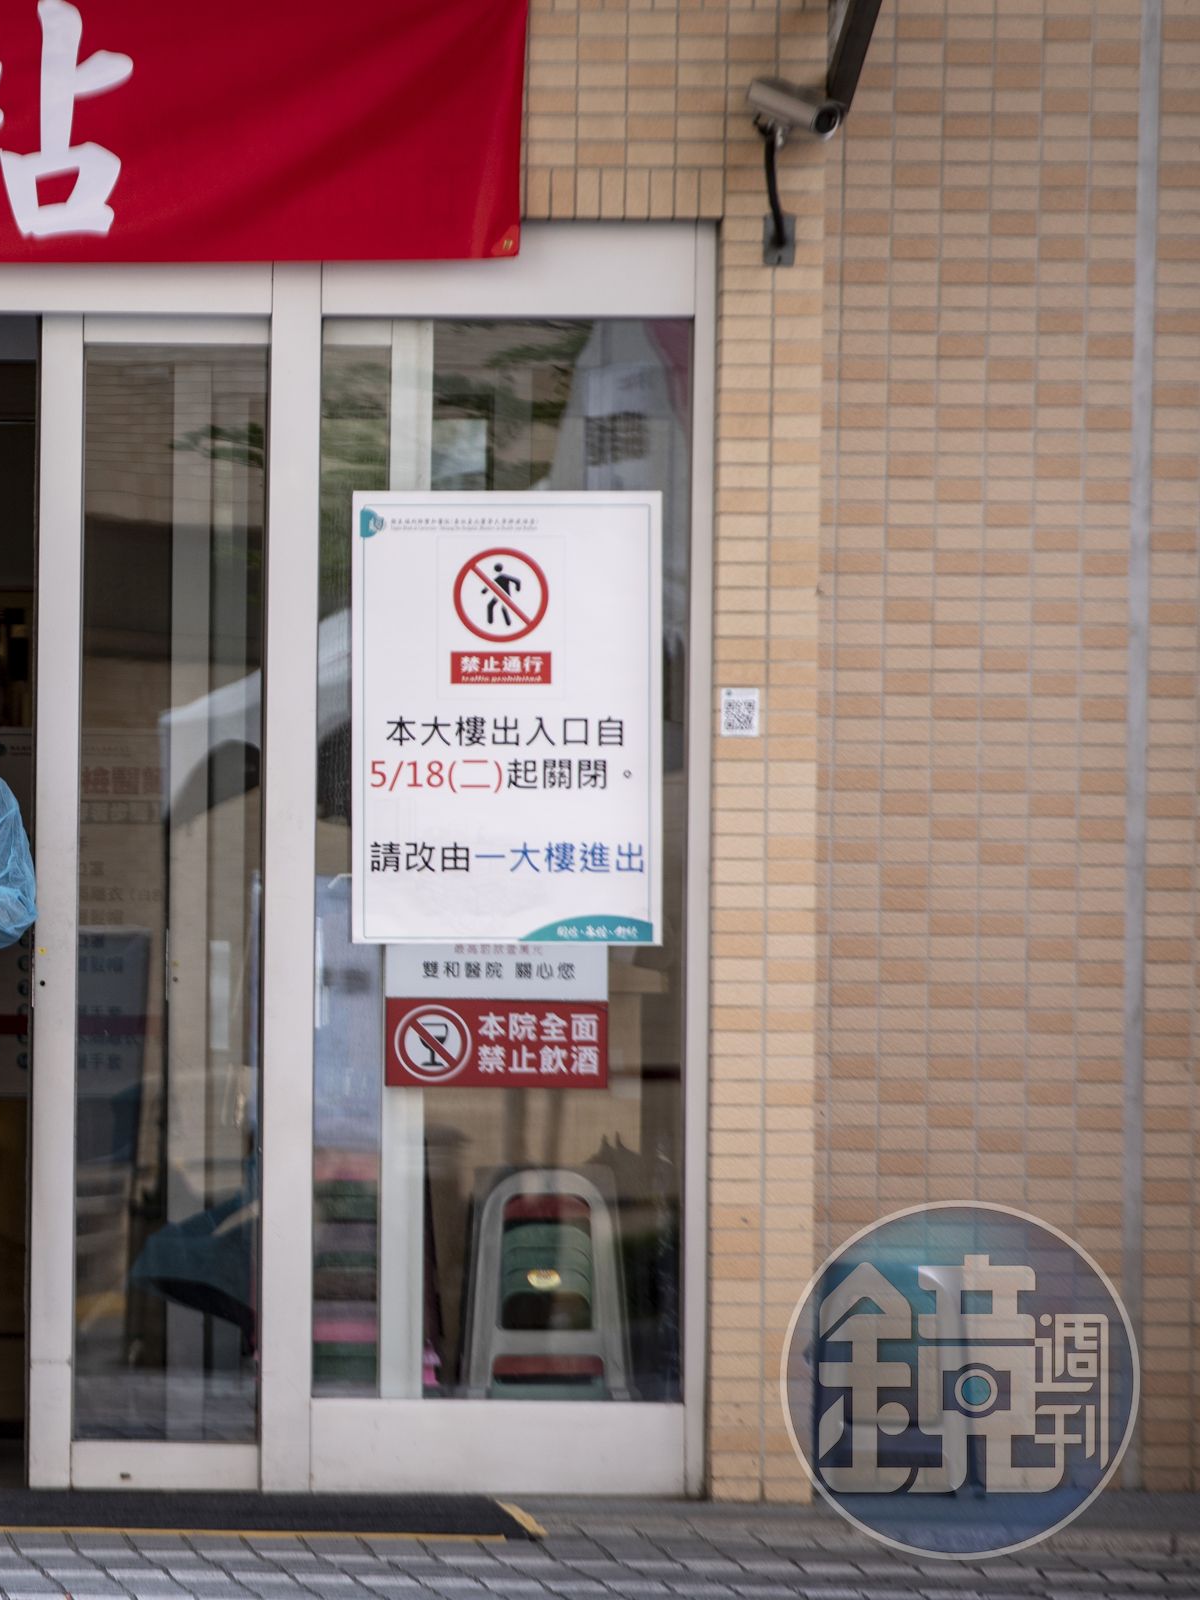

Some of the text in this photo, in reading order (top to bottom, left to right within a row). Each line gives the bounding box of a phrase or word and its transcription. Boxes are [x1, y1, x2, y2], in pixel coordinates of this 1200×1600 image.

[461, 656, 543, 674] 禁止通行
[386, 716, 624, 747] 本大樓出入口自
[370, 758, 632, 793] 5/18(二)起關閉。
[370, 842, 644, 873] 請改由一大樓進出
[422, 961, 503, 980] 雙和醫院
[477, 1011, 599, 1043] 本院全面
[477, 1044, 599, 1076] 禁止飲酒
